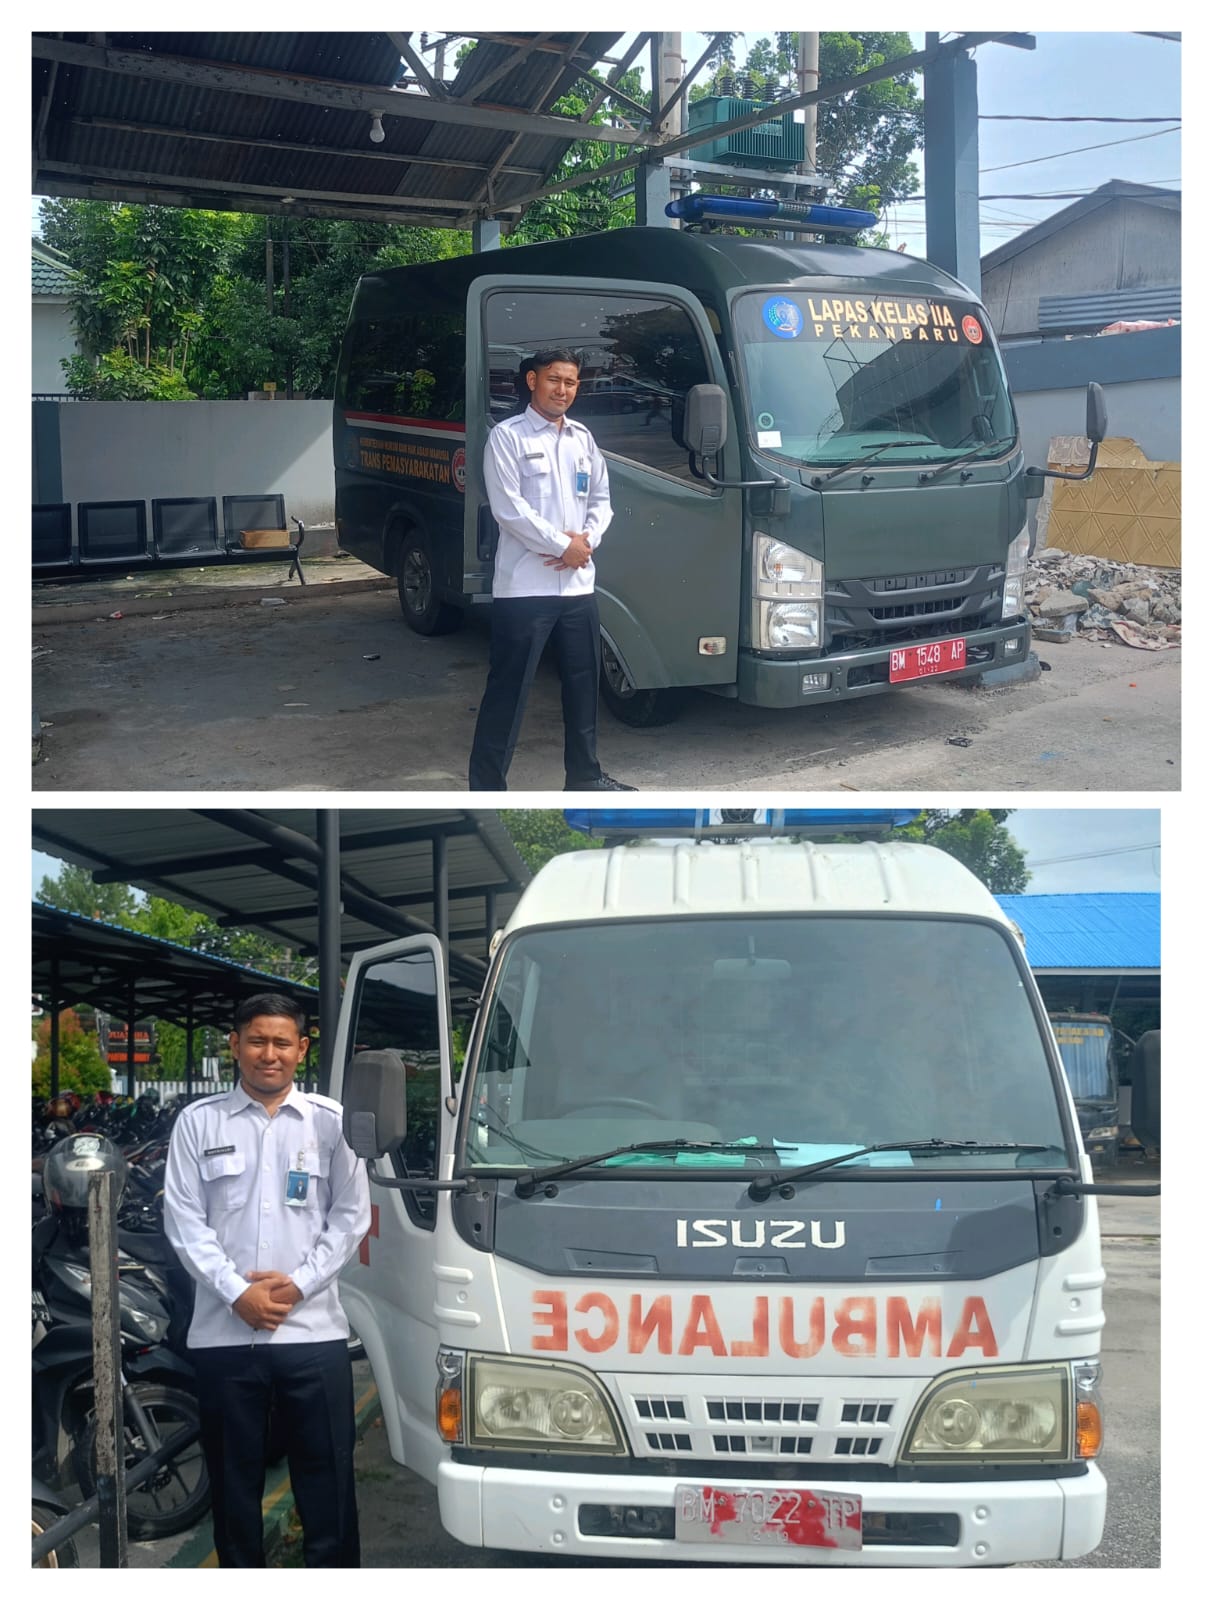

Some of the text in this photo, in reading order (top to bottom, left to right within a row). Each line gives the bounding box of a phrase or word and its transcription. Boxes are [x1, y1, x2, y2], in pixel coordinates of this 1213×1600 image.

[808, 298, 956, 328] LAPAS KELAS IIA
[814, 323, 959, 343] PEKANBARU
[360, 450, 451, 484] TRANS PEMASYARAKATAN
[891, 641, 964, 671] BM 1548 AP
[677, 1218, 846, 1249] ISUZU
[681, 1487, 716, 1523] BM
[734, 1490, 802, 1526] 7022
